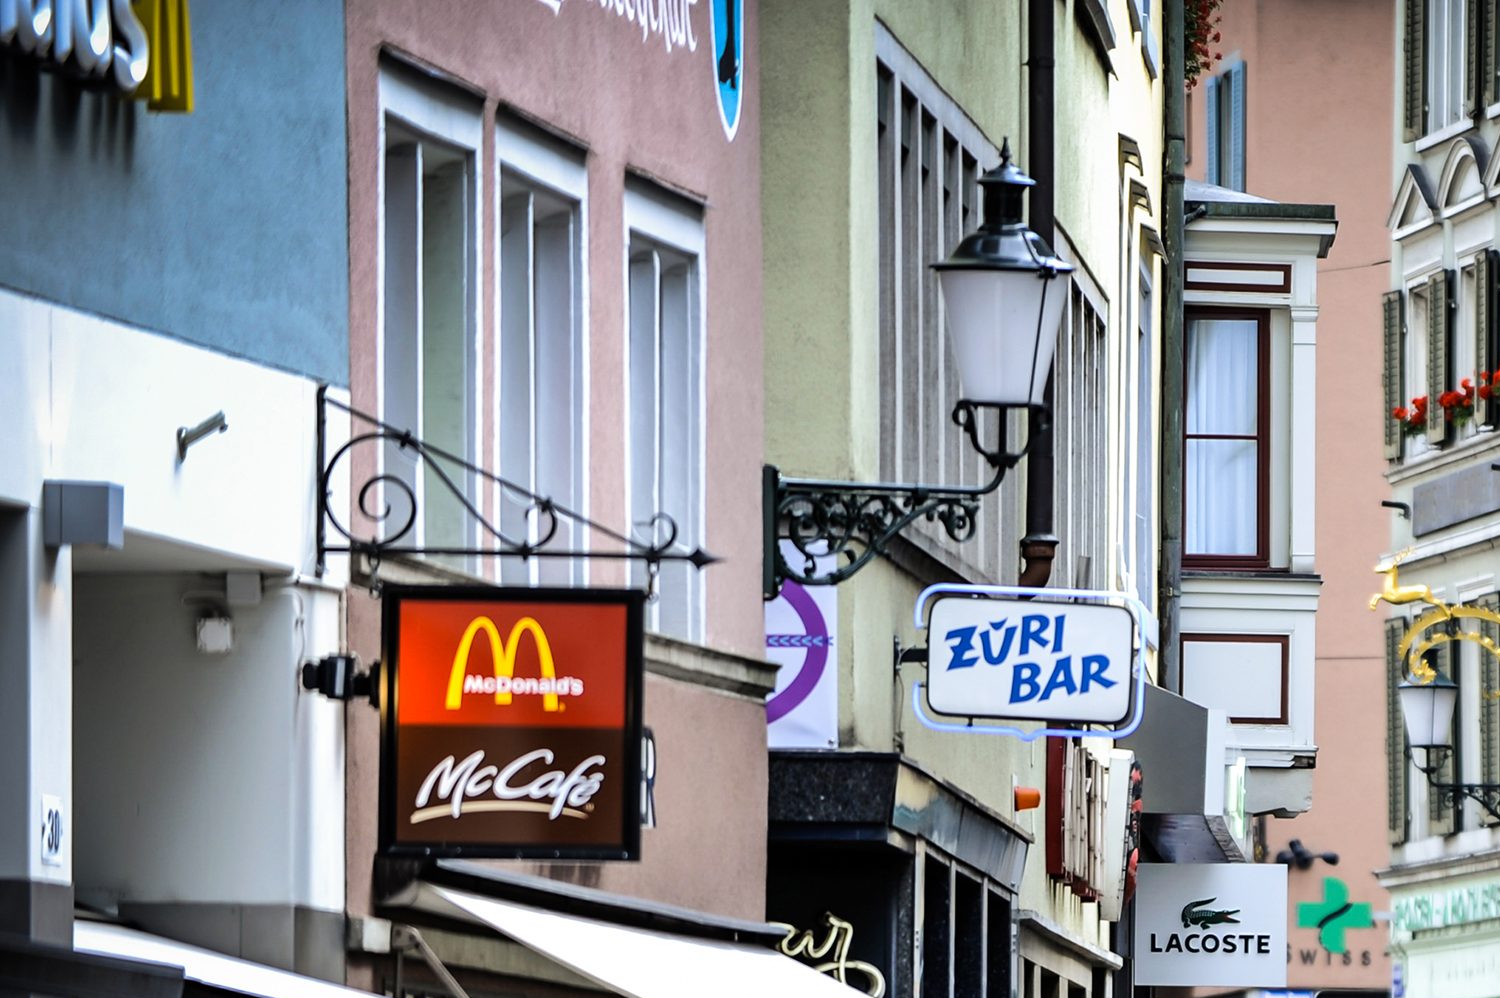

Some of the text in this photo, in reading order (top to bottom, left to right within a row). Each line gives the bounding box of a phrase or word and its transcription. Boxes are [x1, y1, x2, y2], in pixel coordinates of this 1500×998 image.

[463, 674, 584, 696] McDonald's
[1008, 654, 1119, 705] BAR
[47, 807, 60, 854] 30
[1150, 933, 1271, 954] LACOSTE
